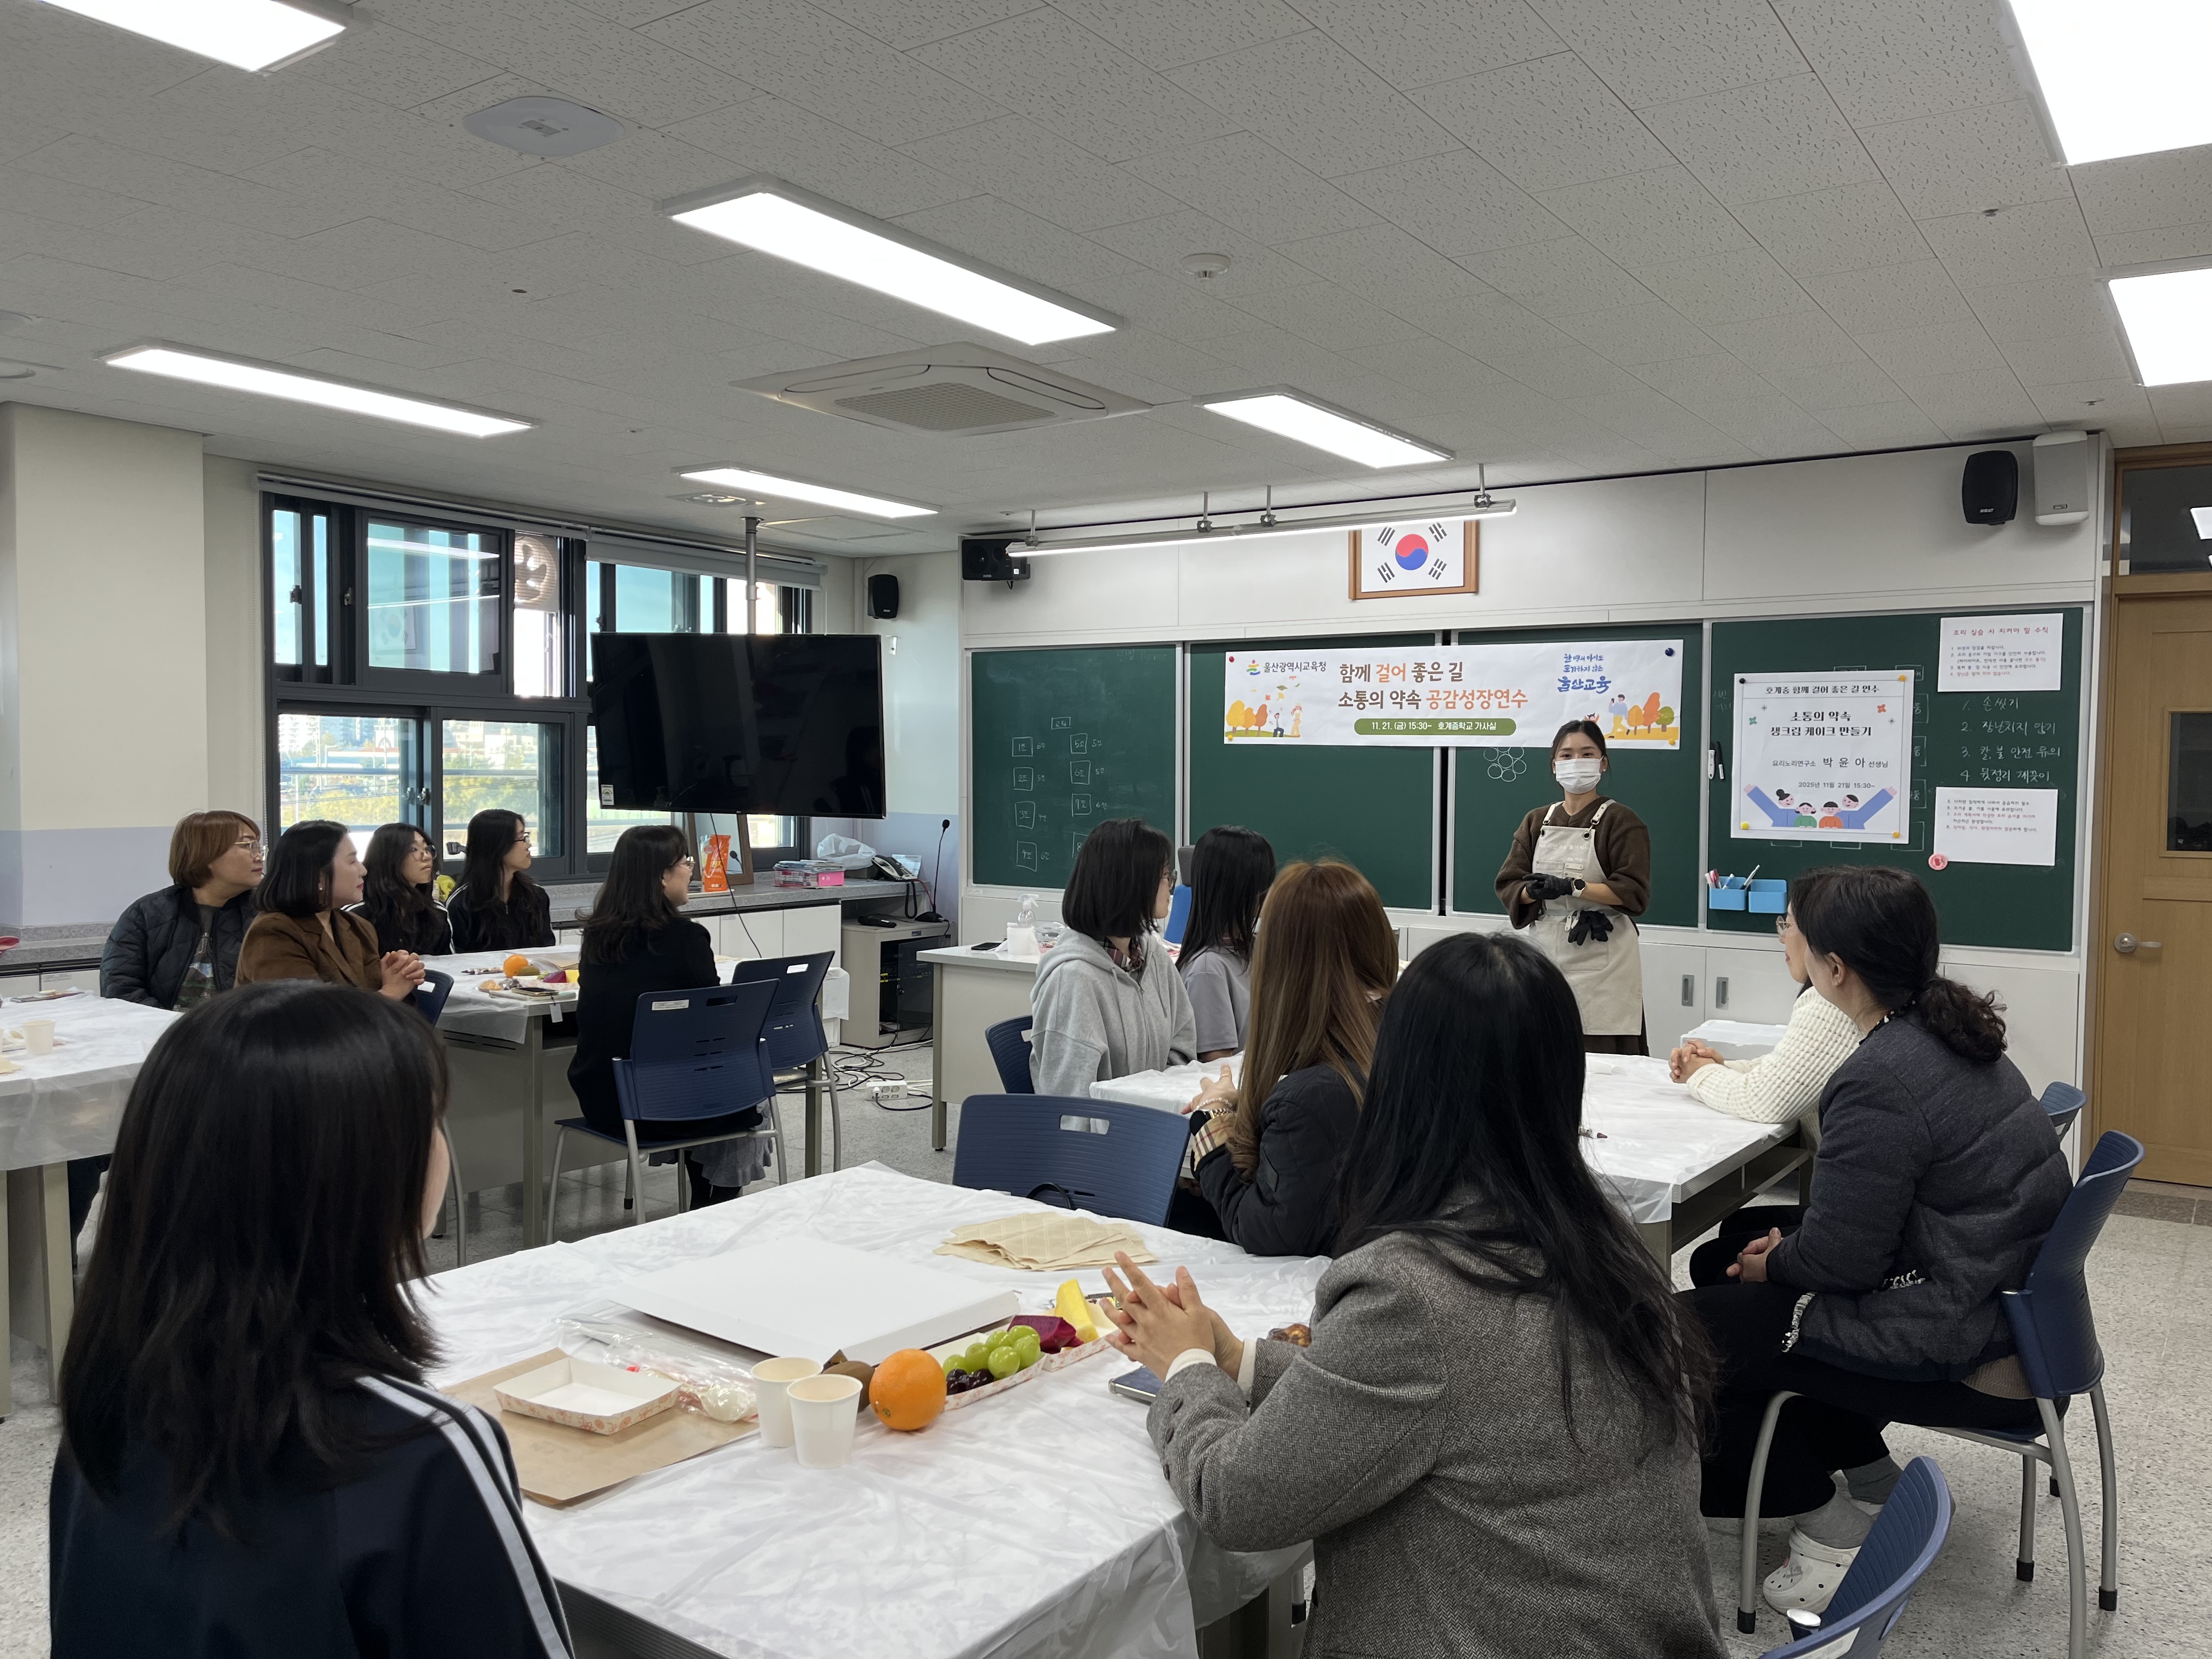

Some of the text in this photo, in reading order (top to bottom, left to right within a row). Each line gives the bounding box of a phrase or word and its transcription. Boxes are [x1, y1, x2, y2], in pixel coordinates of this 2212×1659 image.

[1564, 653, 1572, 663] 한
[1587, 653, 1604, 662] 아이도
[1263, 661, 1326, 673] 울산광역시교육청
[1340, 662, 1463, 682] 함께 걸어 좋은 길
[1563, 664, 1590, 673] 포기하지
[1558, 676, 1611, 694] 울산교육
[1766, 685, 1880, 695] 호계중 함께 걸어 좋은 길 연수
[1338, 689, 1528, 710] 소통의 약속 공감성장연수
[1791, 711, 1851, 721] 소통의 약속
[1372, 721, 1496, 730] 11. 21. (금) 15:30~ 호계중학교 가사실
[1961, 721, 1972, 731] 2.
[1982, 721, 2028, 736] 장난치지
[1770, 726, 1871, 737] 생크림 케이크 만들기
[1962, 746, 1971, 758] 3.
[1996, 746, 2005, 759] 불
[2011, 746, 2033, 759] 안전
[2036, 746, 2061, 758] 유의
[1823, 757, 1833, 768] 박
[1839, 758, 1849, 768] 윤
[1855, 758, 1866, 768] 아
[1980, 768, 2011, 782] 뒷정리
